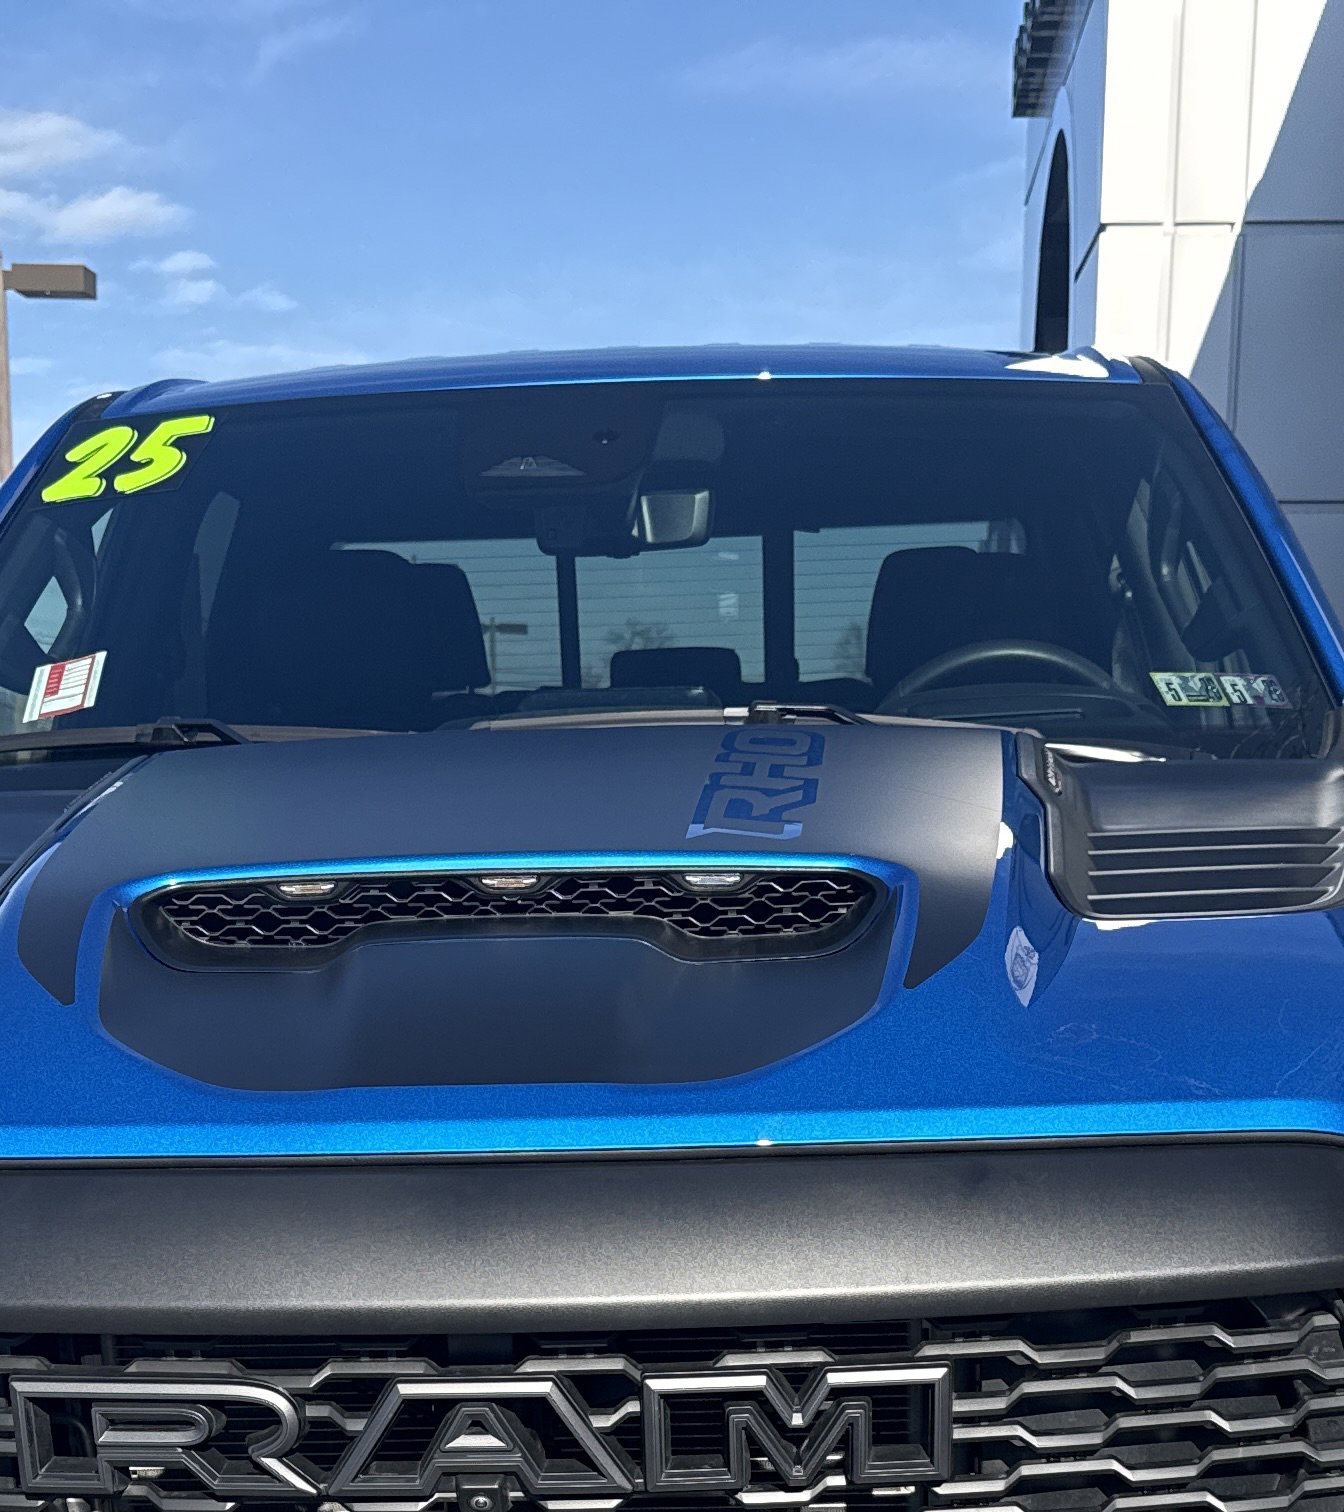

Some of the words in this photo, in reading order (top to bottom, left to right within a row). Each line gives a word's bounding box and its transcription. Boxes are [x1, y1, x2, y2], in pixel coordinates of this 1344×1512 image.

[41, 414, 215, 503] 25
[686, 728, 825, 840] RHO
[8, 1361, 956, 1499] RAM
